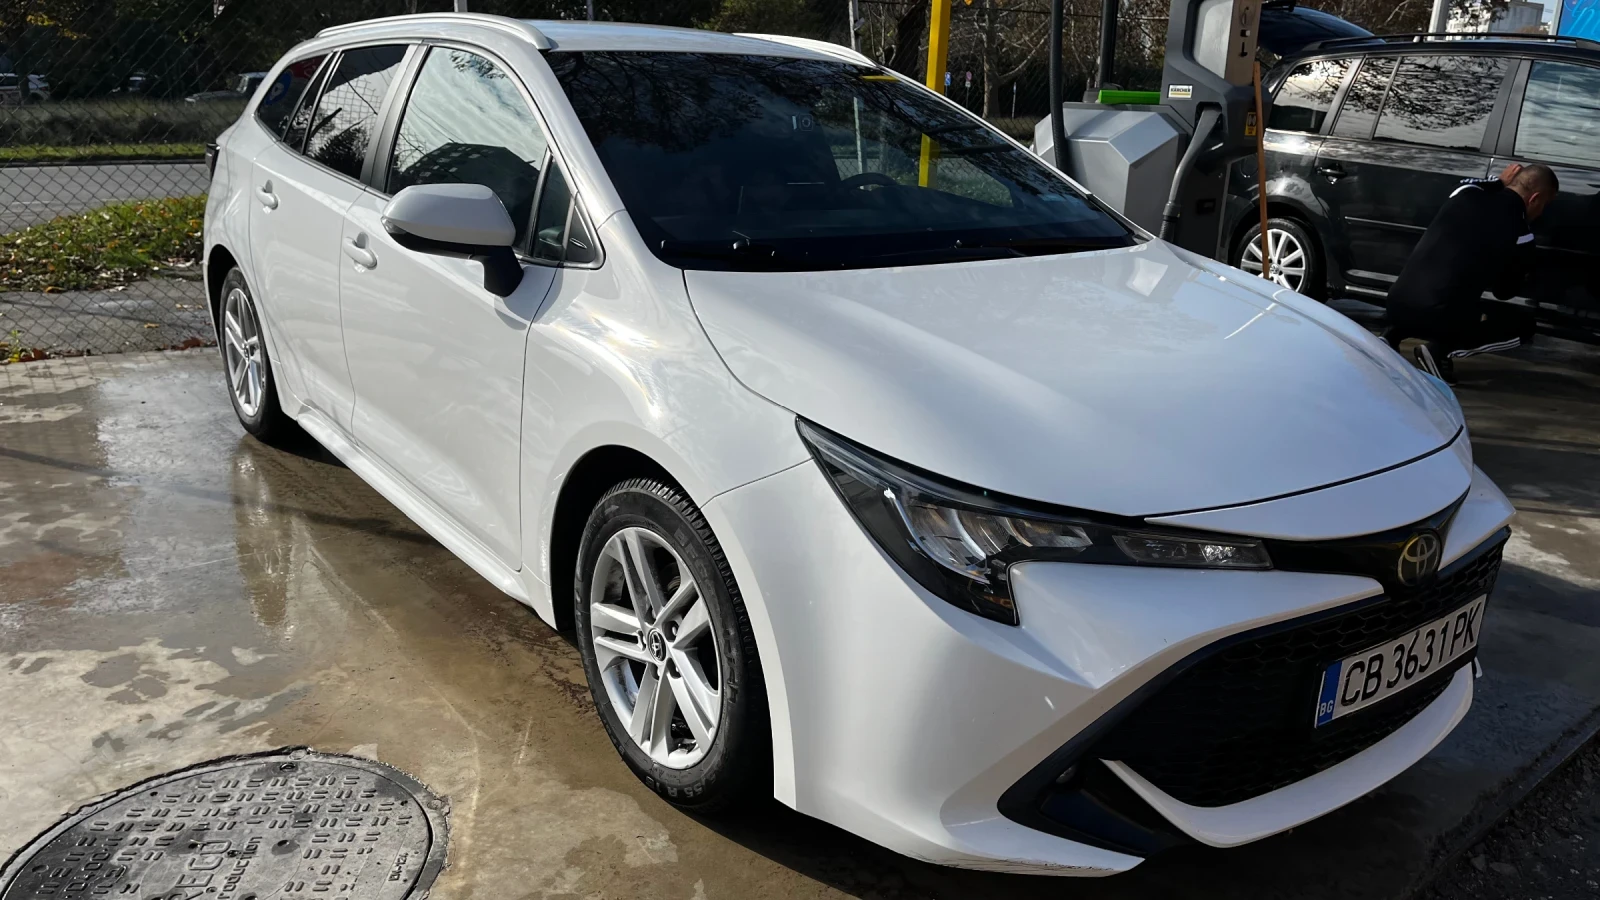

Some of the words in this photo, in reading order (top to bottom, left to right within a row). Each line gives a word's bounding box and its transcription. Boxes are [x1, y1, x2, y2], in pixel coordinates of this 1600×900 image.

[1340, 653, 1384, 706] CB
[1386, 620, 1449, 689] 3631
[1449, 602, 1482, 657] PK
[1319, 700, 1334, 717] BG
[216, 836, 263, 900] roduction
